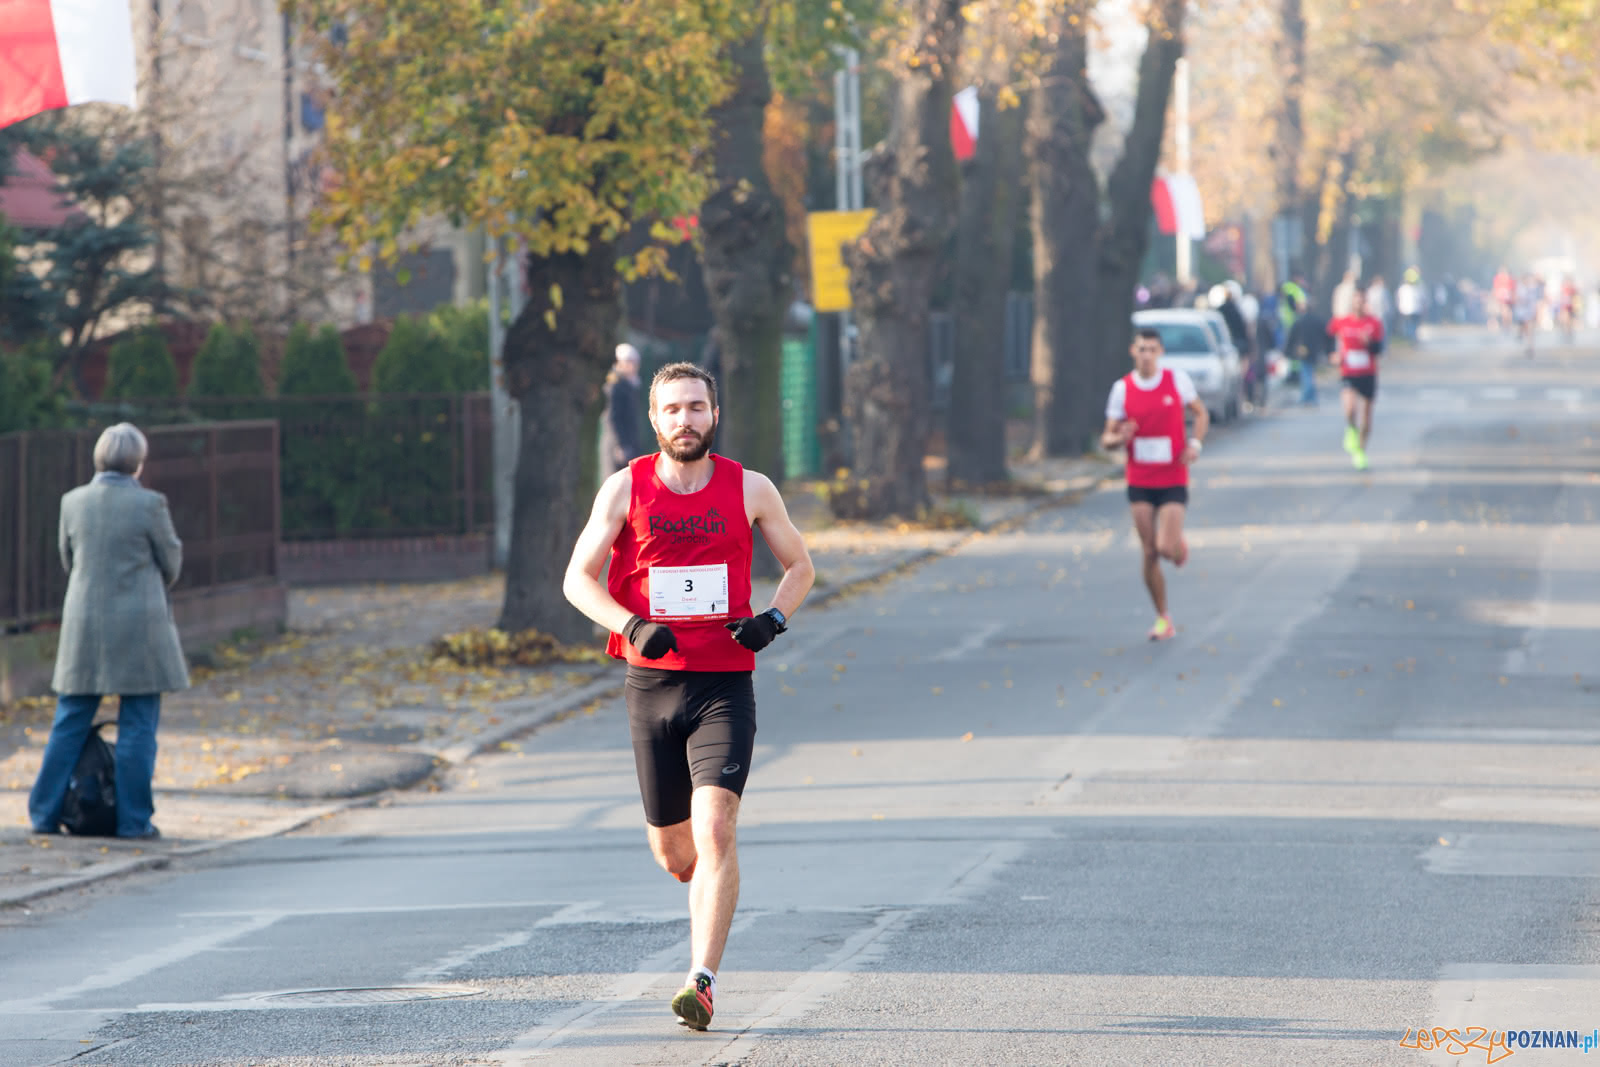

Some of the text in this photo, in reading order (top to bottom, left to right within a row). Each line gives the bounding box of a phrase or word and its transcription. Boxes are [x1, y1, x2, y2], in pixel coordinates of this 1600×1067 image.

[649, 515, 726, 535] RockRun
[671, 535, 708, 544] Jarocin
[684, 579, 694, 592] 3
